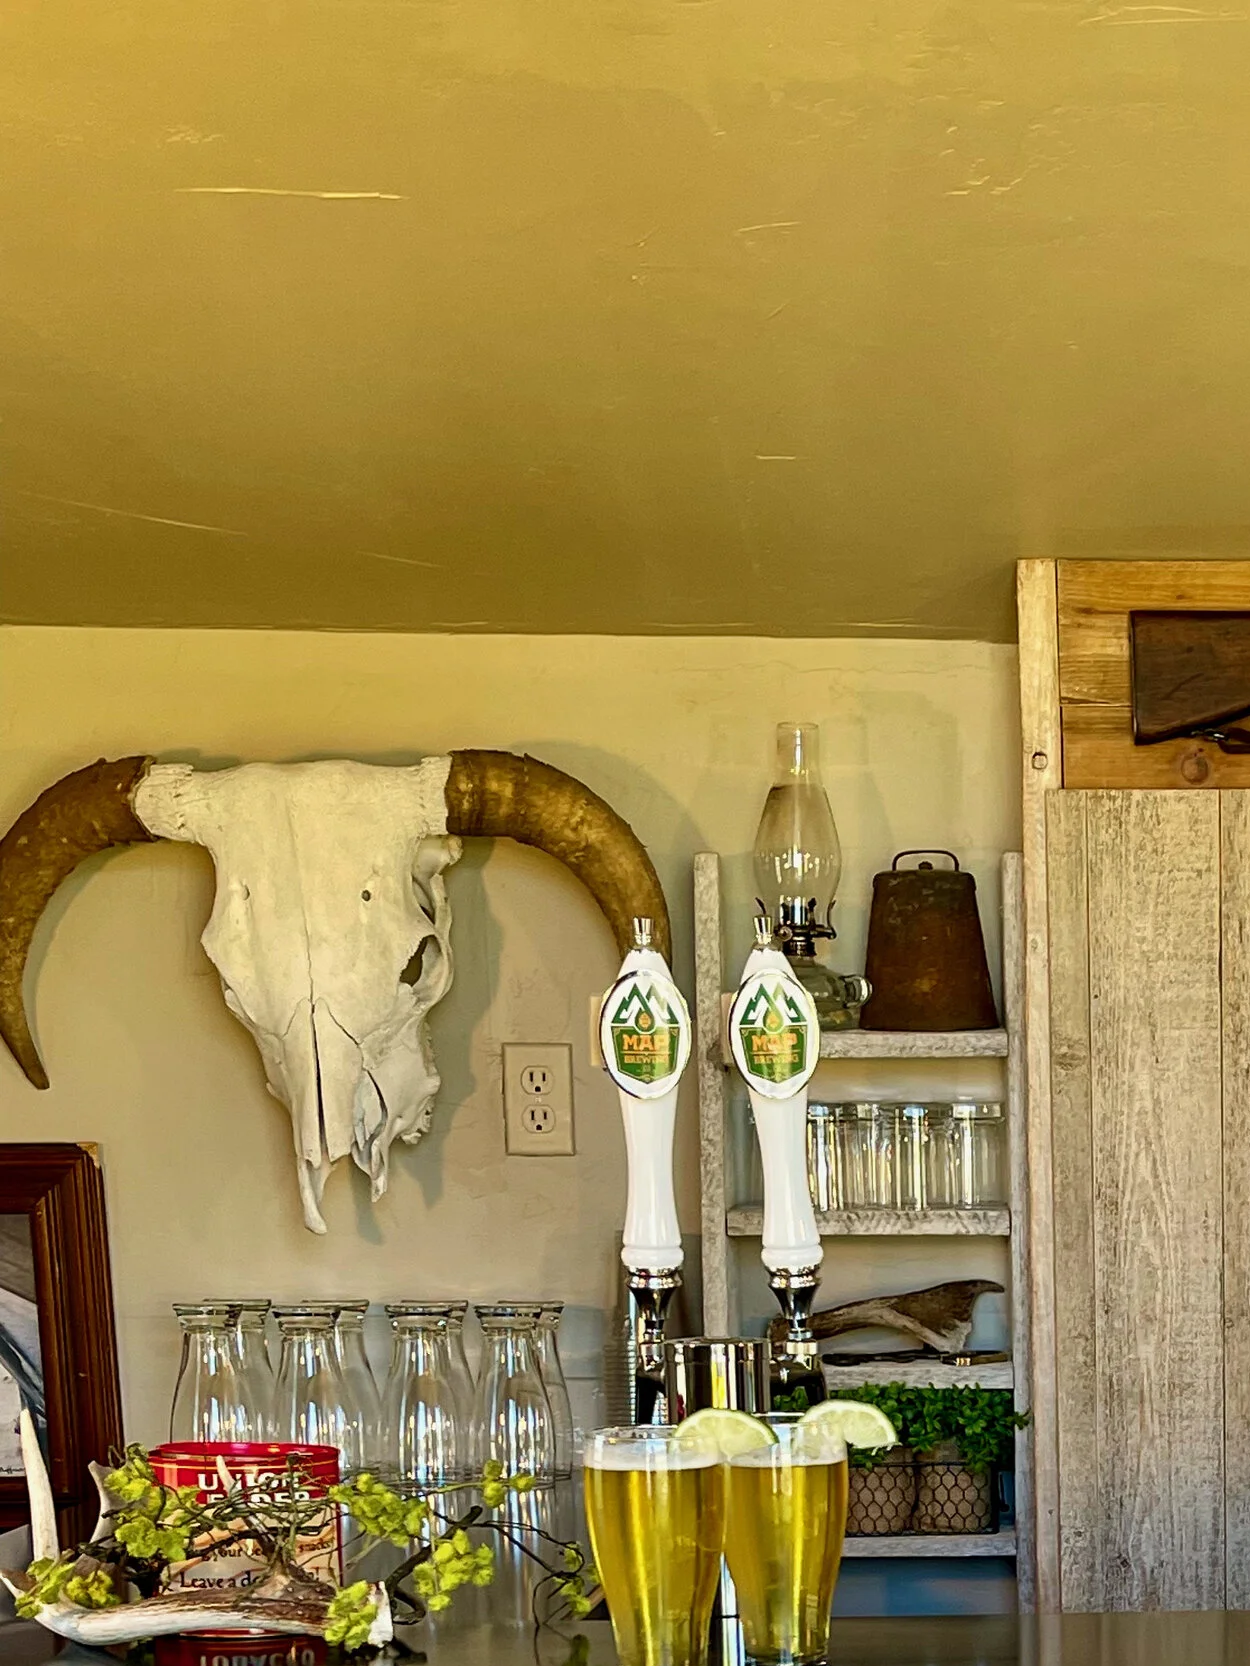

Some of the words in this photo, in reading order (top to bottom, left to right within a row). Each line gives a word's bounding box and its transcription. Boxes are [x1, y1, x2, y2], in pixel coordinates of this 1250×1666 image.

[622, 1034, 670, 1051] MAP
[751, 1032, 798, 1051] MAP
[180, 1570, 223, 1589] Leave
[227, 1578, 236, 1588] a
